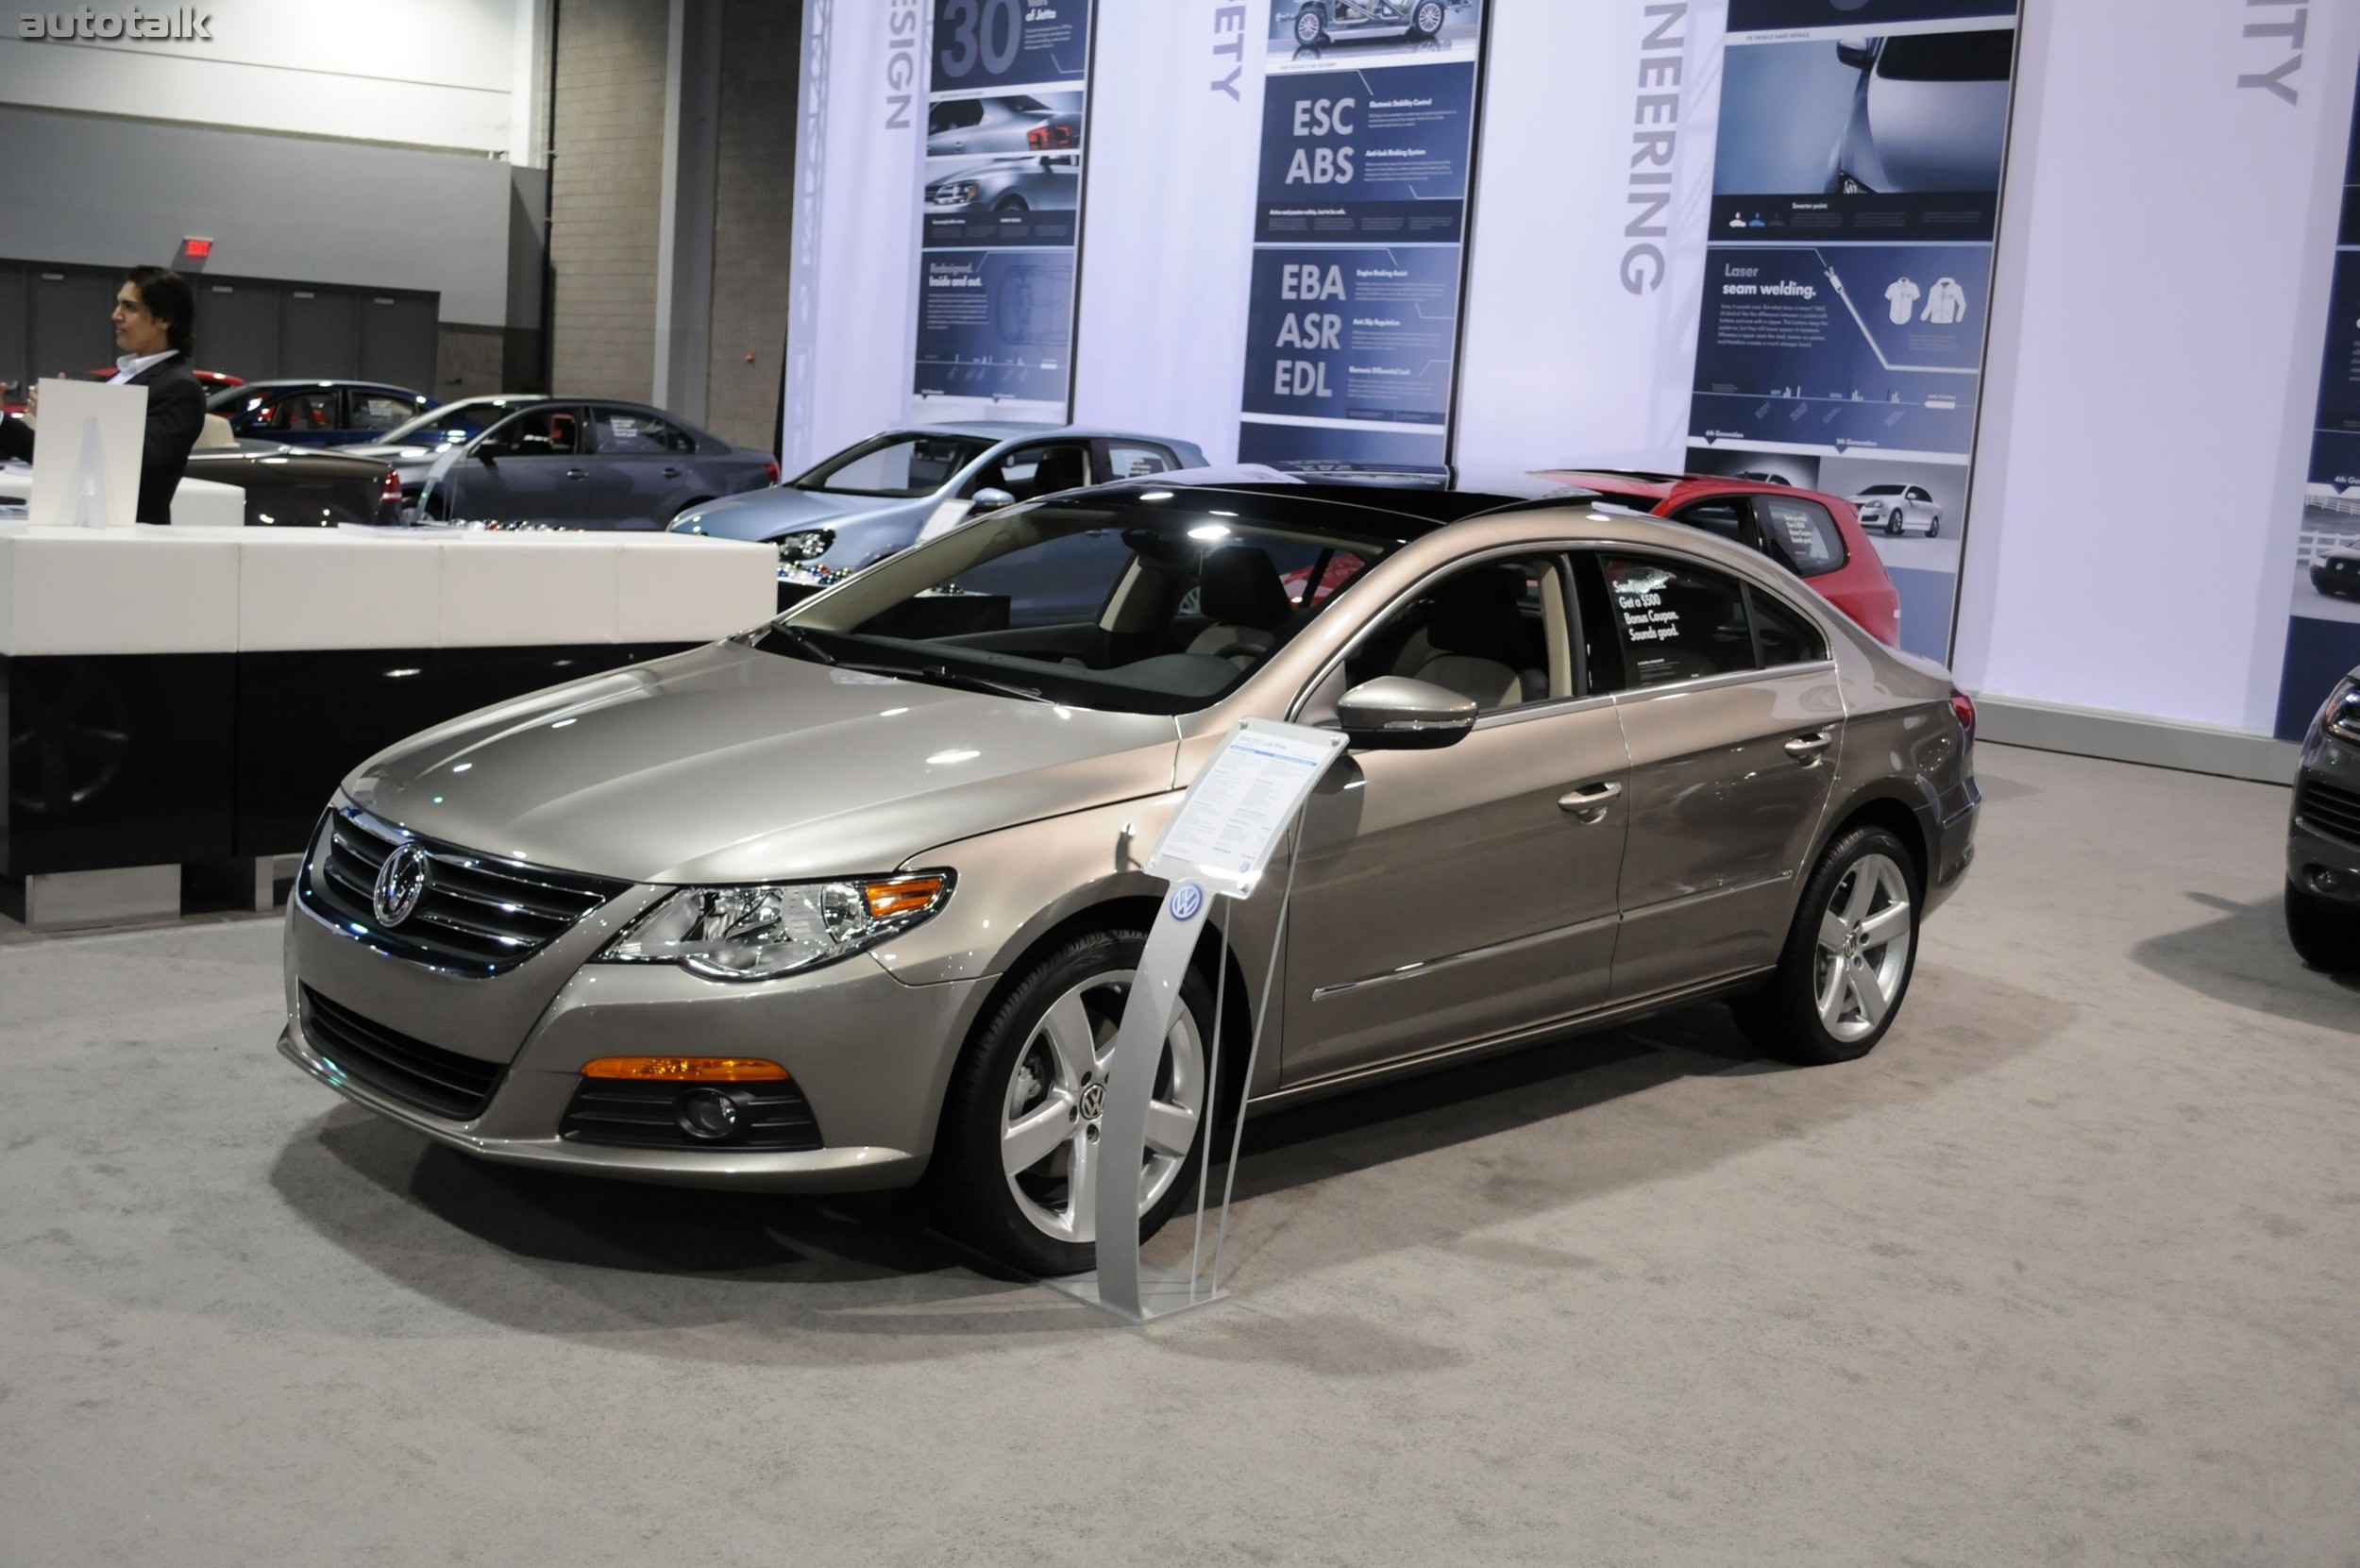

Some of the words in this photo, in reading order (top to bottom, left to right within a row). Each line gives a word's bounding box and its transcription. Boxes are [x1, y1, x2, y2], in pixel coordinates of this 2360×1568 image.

[941, 0, 1021, 77] 30
[1293, 97, 1356, 137] ESC
[1285, 146, 1355, 184] ABS
[1619, 2, 1688, 295] NEERING
[929, 276, 951, 287] Inside
[952, 276, 968, 287] and
[1281, 264, 1346, 300] EBA
[1725, 263, 1759, 278] Laser
[1722, 283, 1757, 295] seam
[1760, 280, 1816, 299] welding.
[1275, 312, 1341, 349] ASR
[1274, 360, 1332, 397] EDL
[1618, 596, 1635, 609] Get
[1635, 599, 1641, 607] a
[1641, 593, 1661, 608] $500
[1624, 612, 1649, 624] Bonus
[1648, 610, 1679, 624] Coupon.
[1629, 626, 1657, 641] Sounds
[1658, 623, 1679, 641] good.
